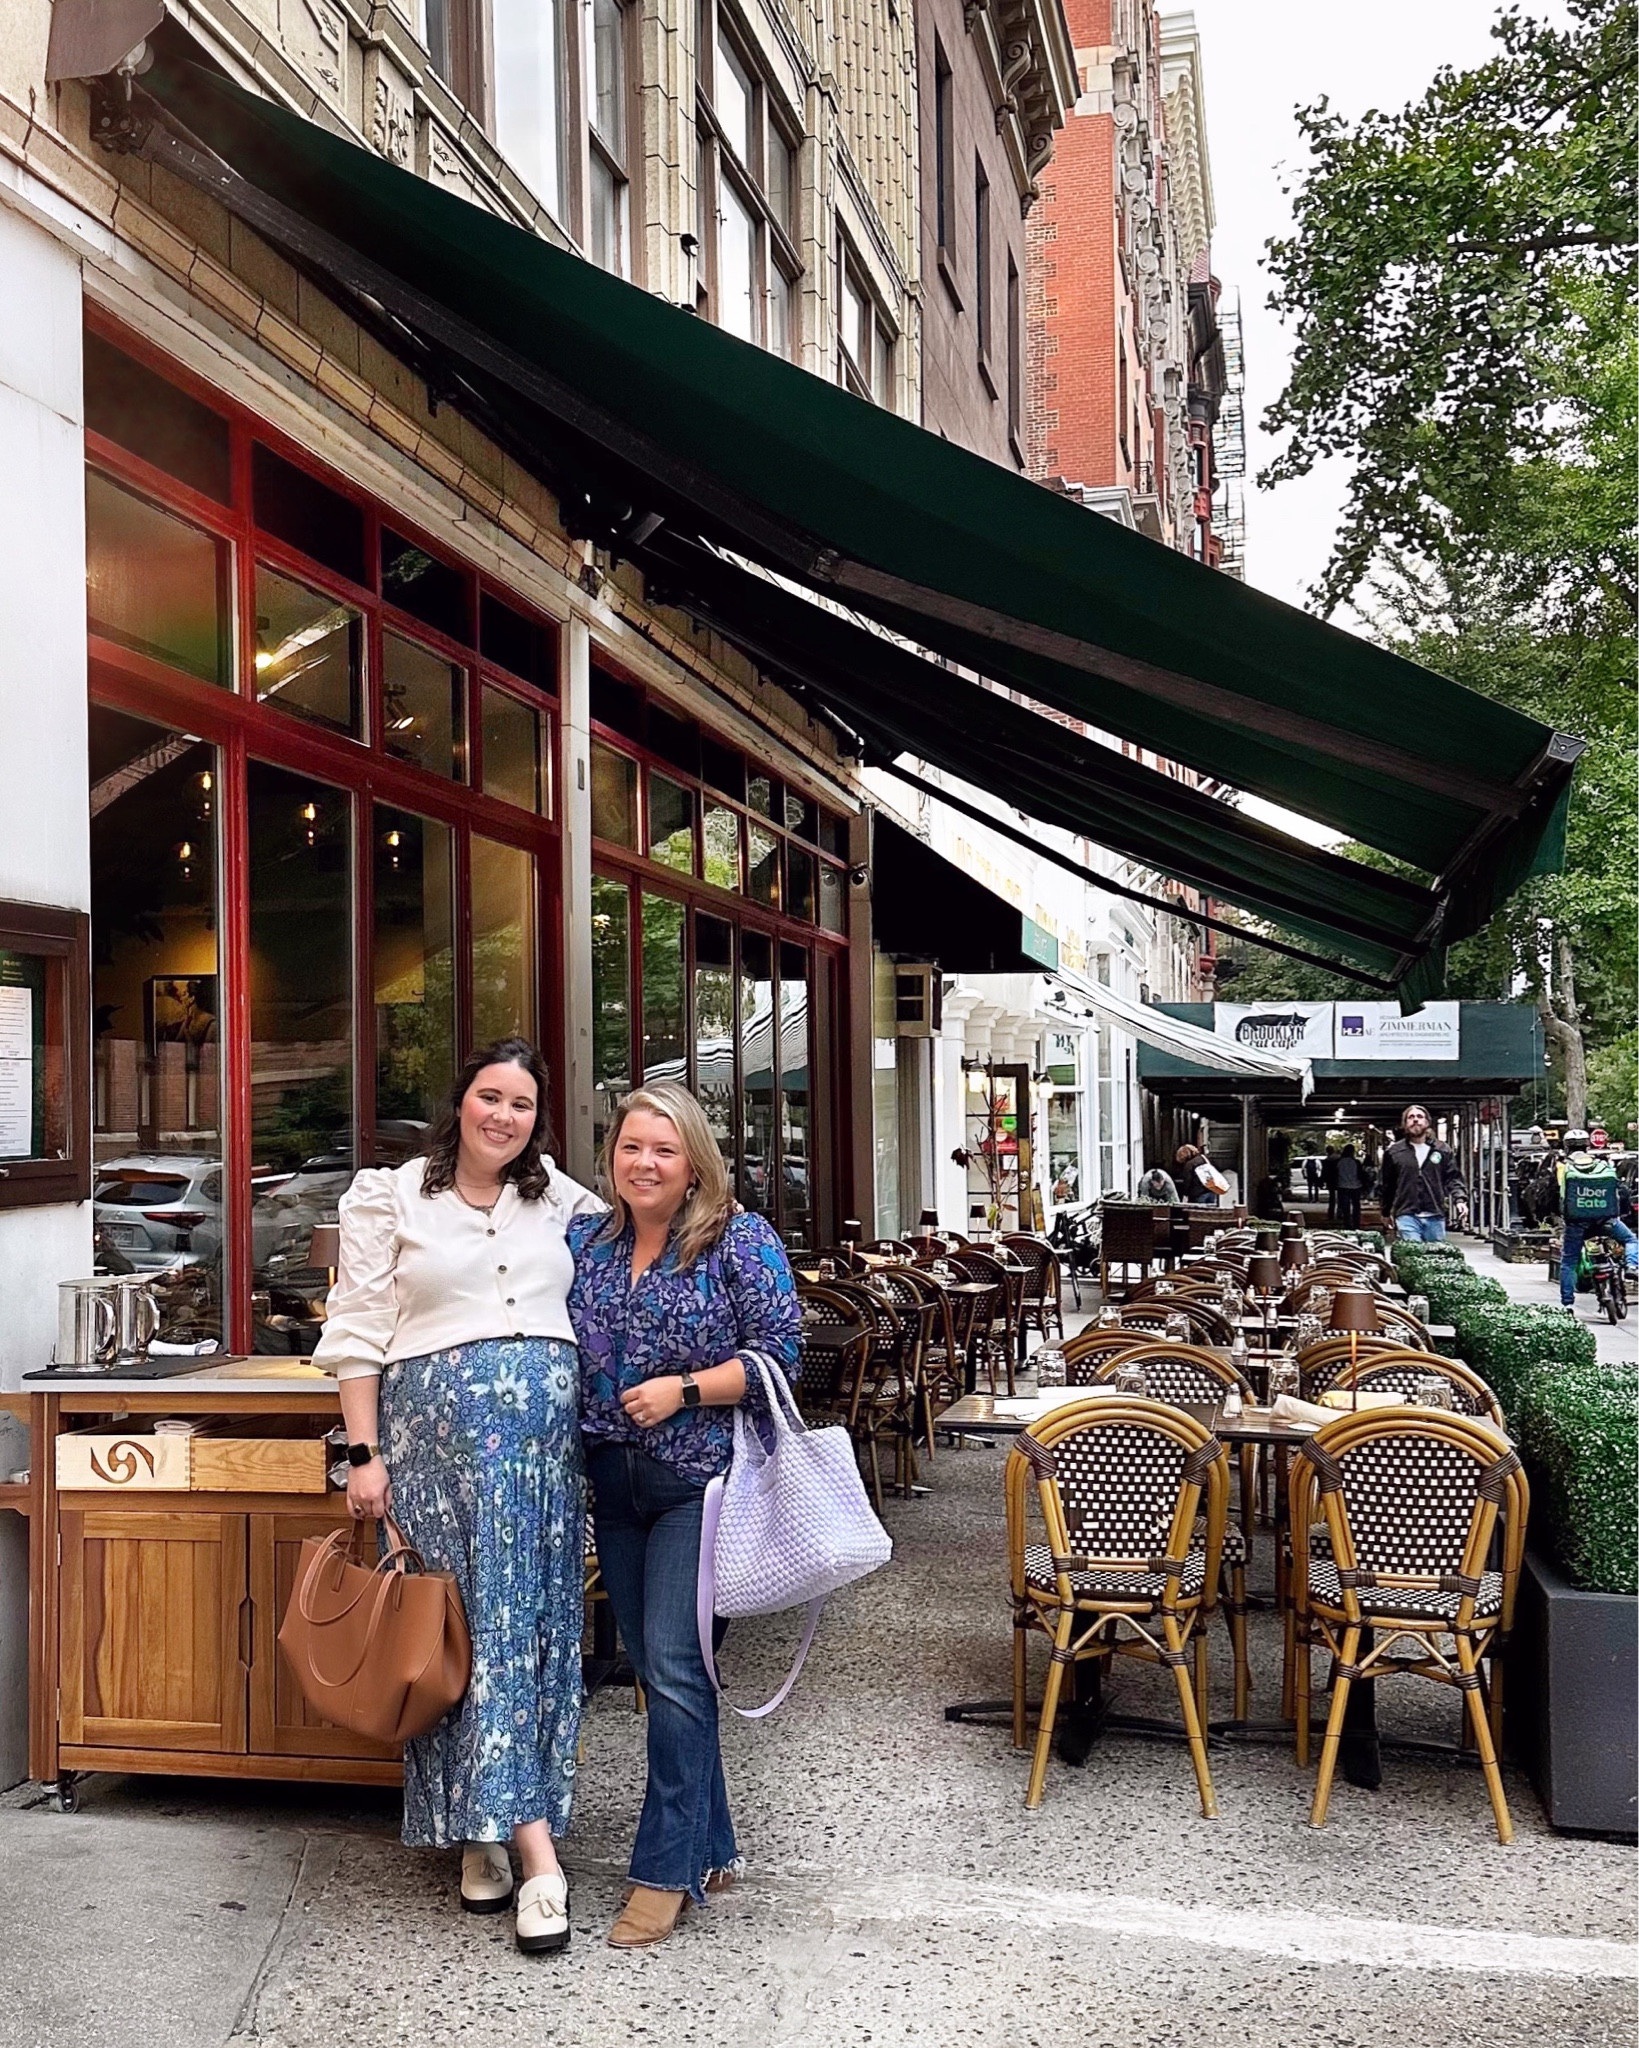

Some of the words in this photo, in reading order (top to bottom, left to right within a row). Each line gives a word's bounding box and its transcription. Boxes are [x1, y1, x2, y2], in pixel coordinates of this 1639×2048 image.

[1379, 1021, 1451, 1031] ZIMMERMAN
[1242, 1024, 1304, 1040] BROOKLYN
[1342, 1027, 1362, 1036] HLZ
[1249, 1038, 1268, 1048] cat
[1576, 1186, 1607, 1197] Uber
[1576, 1197, 1607, 1208] Eats
